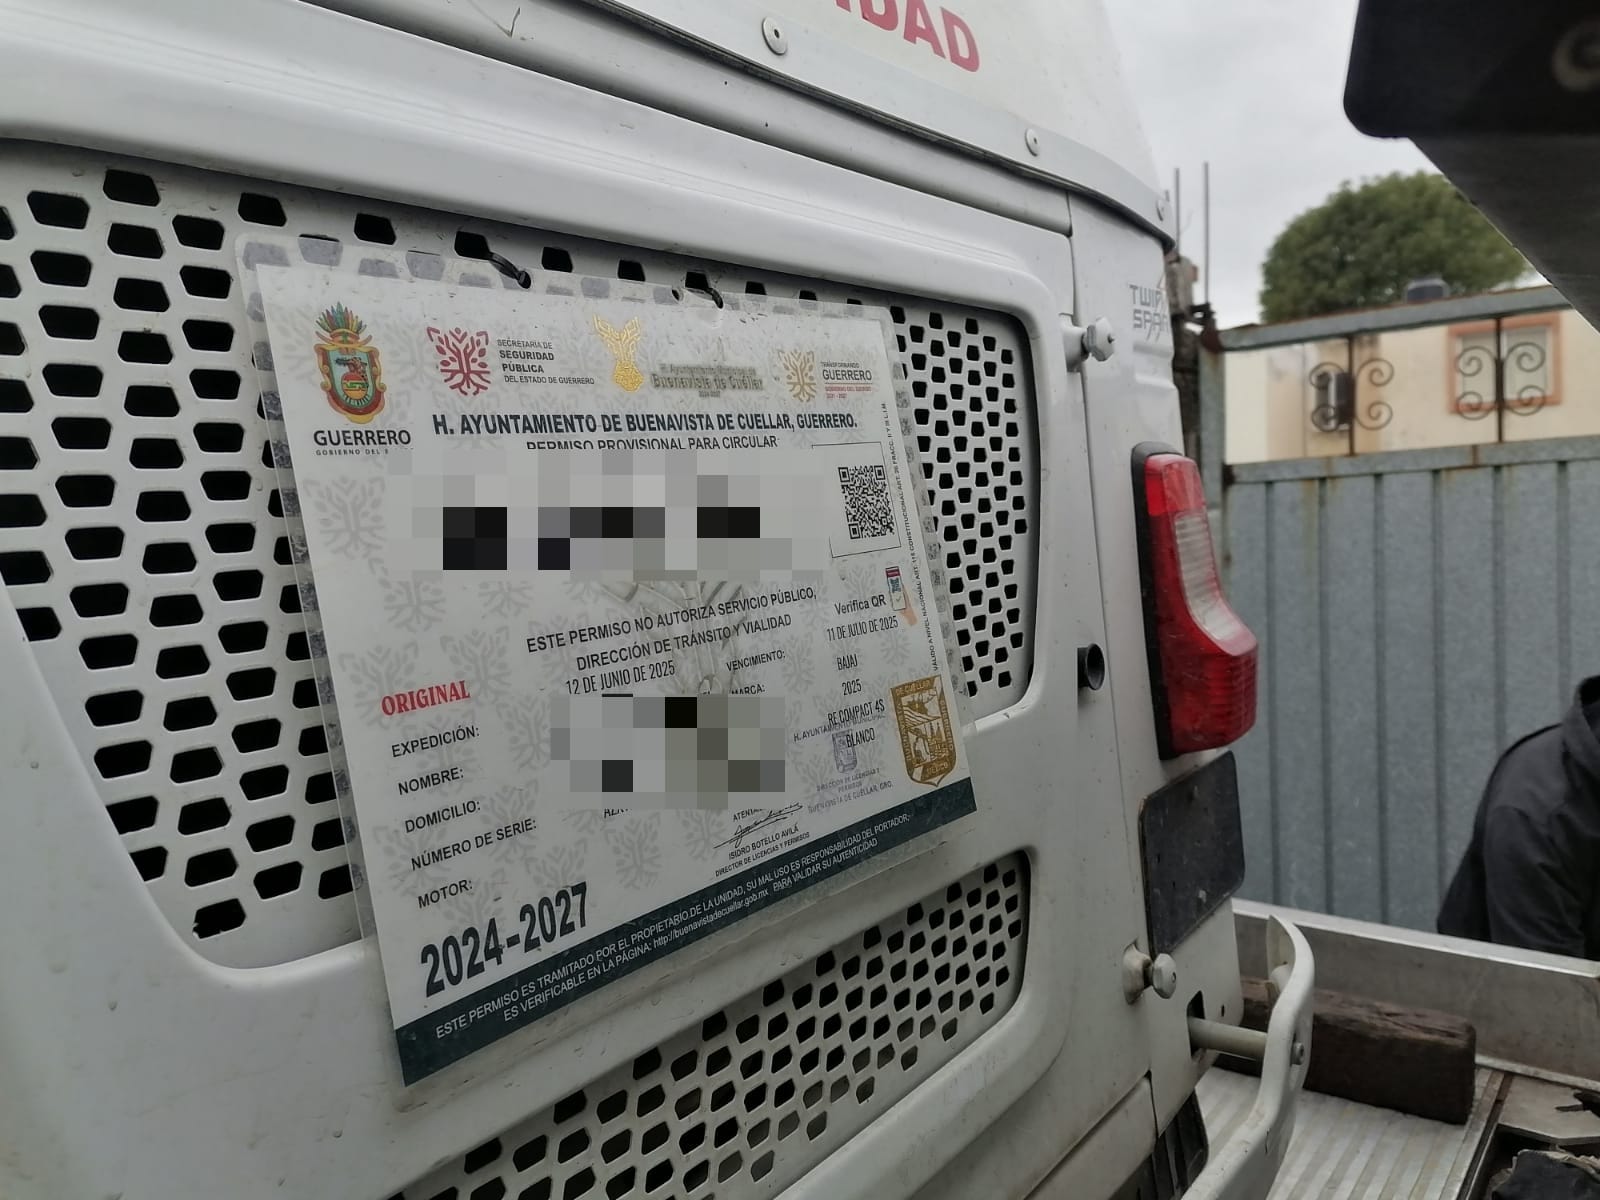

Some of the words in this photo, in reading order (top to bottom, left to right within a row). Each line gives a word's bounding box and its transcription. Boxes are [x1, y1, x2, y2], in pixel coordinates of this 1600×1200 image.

[836, 0, 979, 72] DAD
[499, 350, 554, 361] SEGURIDAD
[502, 361, 544, 373] PÚBLICA
[504, 375, 519, 383] DEL
[520, 376, 547, 384] ESTADO
[559, 377, 595, 385] GUERRERO
[822, 369, 872, 381] GUERRERO
[313, 430, 411, 446] GUERRERO
[432, 414, 455, 435] H.
[461, 414, 597, 435] AYUNTAMIENTO
[601, 414, 623, 432] DE
[625, 413, 714, 433] BUENAVISTA
[716, 413, 735, 430] DE
[737, 413, 795, 432] CUELLAR,
[796, 413, 858, 429] GUERRERO.
[598, 438, 687, 450] PROVISIONAL
[688, 437, 720, 450] PARA
[722, 435, 778, 449] CIRCULAR
[898, 491, 915, 552] CONSTITUCIONAL
[834, 597, 869, 616] Verifica
[871, 594, 887, 608] QR
[915, 580, 927, 617] NACIONAL
[526, 632, 566, 653] ESTE
[568, 620, 631, 645] PERMISO
[634, 616, 654, 633] NO
[657, 605, 717, 628] AUTORIZA
[717, 595, 769, 616] SERVICIO
[770, 586, 817, 606] PÚBLICO,
[826, 628, 835, 642] 11
[837, 625, 847, 640] DE
[848, 620, 868, 638] JULIO
[869, 619, 878, 632] DE
[879, 615, 899, 631] 2025
[924, 618, 932, 638] NIVEL
[576, 641, 651, 671] DIRECCIÓN
[654, 638, 672, 654] DE
[674, 626, 731, 650] TRÁNSITO
[732, 624, 741, 637] Y
[742, 614, 792, 635] VIALIDAD
[726, 649, 786, 672] VENCIMIENTO:
[836, 654, 858, 671] BAJAJ
[566, 678, 581, 695] 12
[583, 675, 598, 694] DE
[600, 668, 631, 690] JUNIO
[633, 665, 647, 683] DE
[649, 660, 676, 680] 2025
[841, 678, 862, 696] 2025
[381, 680, 471, 716] ORIGINAL
[828, 711, 837, 726] RE
[838, 702, 873, 725] COMPACT
[875, 699, 885, 713] 4S
[391, 725, 480, 758] EXPEDICIÓN:
[846, 727, 875, 748] BLANCO
[398, 766, 464, 796] NOMBRE:
[404, 800, 481, 834] DOMICILIO:
[411, 840, 472, 871] NÚMERO
[474, 832, 493, 849] DE
[496, 818, 537, 841] SERIE:
[715, 859, 743, 877] DIRECTOR
[743, 857, 752, 865] DE
[752, 845, 780, 861] LICENCIAS
[784, 832, 810, 847] PERMISOS
[729, 845, 751, 860] ISIDRO
[752, 833, 780, 850] BOTELLO
[418, 879, 473, 909] MOTOR:
[420, 881, 588, 999] 2024-2027
[435, 1014, 467, 1039] ESTE
[468, 989, 520, 1022] PERMISO
[521, 981, 536, 997] ES
[537, 953, 595, 990] TRAMITADO
[595, 943, 617, 960] POR
[618, 938, 631, 951] EL
[631, 910, 688, 945] PROPIETARIO
[689, 904, 702, 918] DE
[702, 899, 714, 912] LA
[714, 885, 746, 906] UNIDAD,
[746, 879, 758, 892] SU
[757, 872, 774, 887] MAL
[773, 864, 790, 879] USO
[790, 860, 801, 872] ES
[801, 831, 862, 866] RESPONSABILIDAD
[861, 828, 875, 840] DEL
[503, 1005, 519, 1022] ES
[520, 972, 586, 1013] VERIFICABLE
[587, 965, 601, 980] EN
[602, 960, 615, 973] LA
[615, 942, 652, 967] PÁGINA:
[773, 876, 793, 892] PARA
[792, 863, 822, 883] VALIDAR
[822, 859, 832, 870] SU
[832, 837, 878, 865] AUTENTICIDAD
